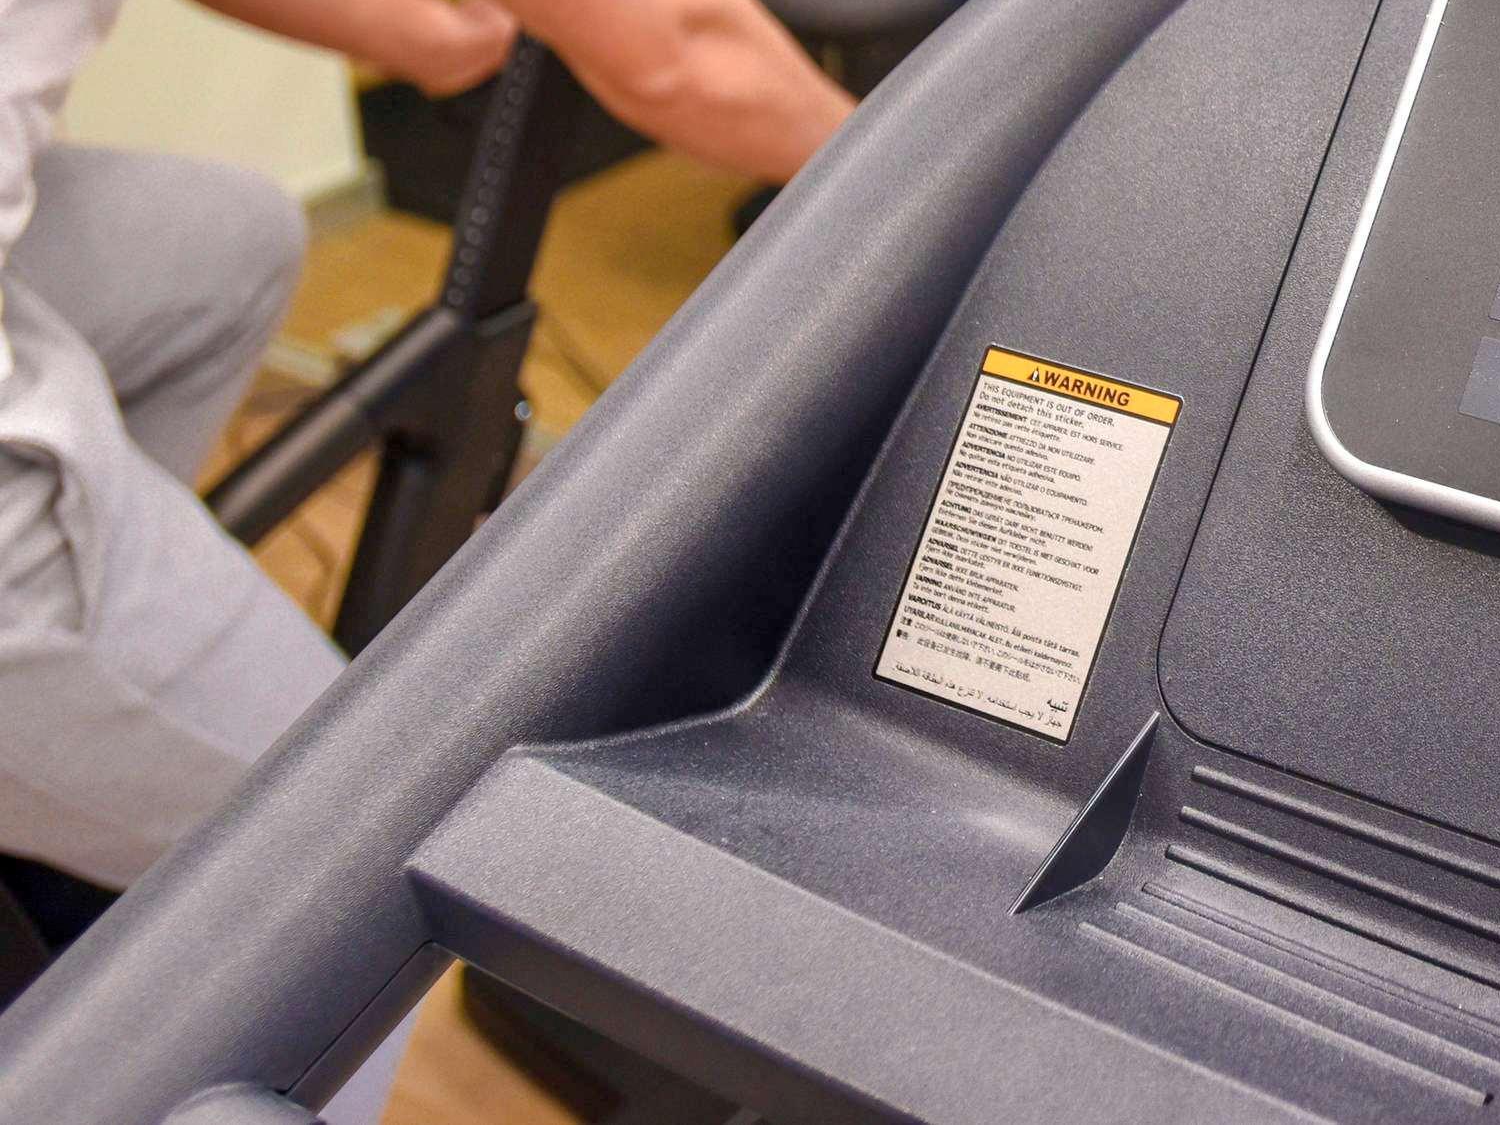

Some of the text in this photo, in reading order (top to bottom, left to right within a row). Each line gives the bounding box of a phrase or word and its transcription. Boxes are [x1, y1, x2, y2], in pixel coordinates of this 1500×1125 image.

[983, 381, 1114, 427] THIS EQUIPMENT IS OUT OF ORDER.
[1044, 370, 1129, 406] WARNING
[978, 390, 1084, 428] Do not detach this sticker.
